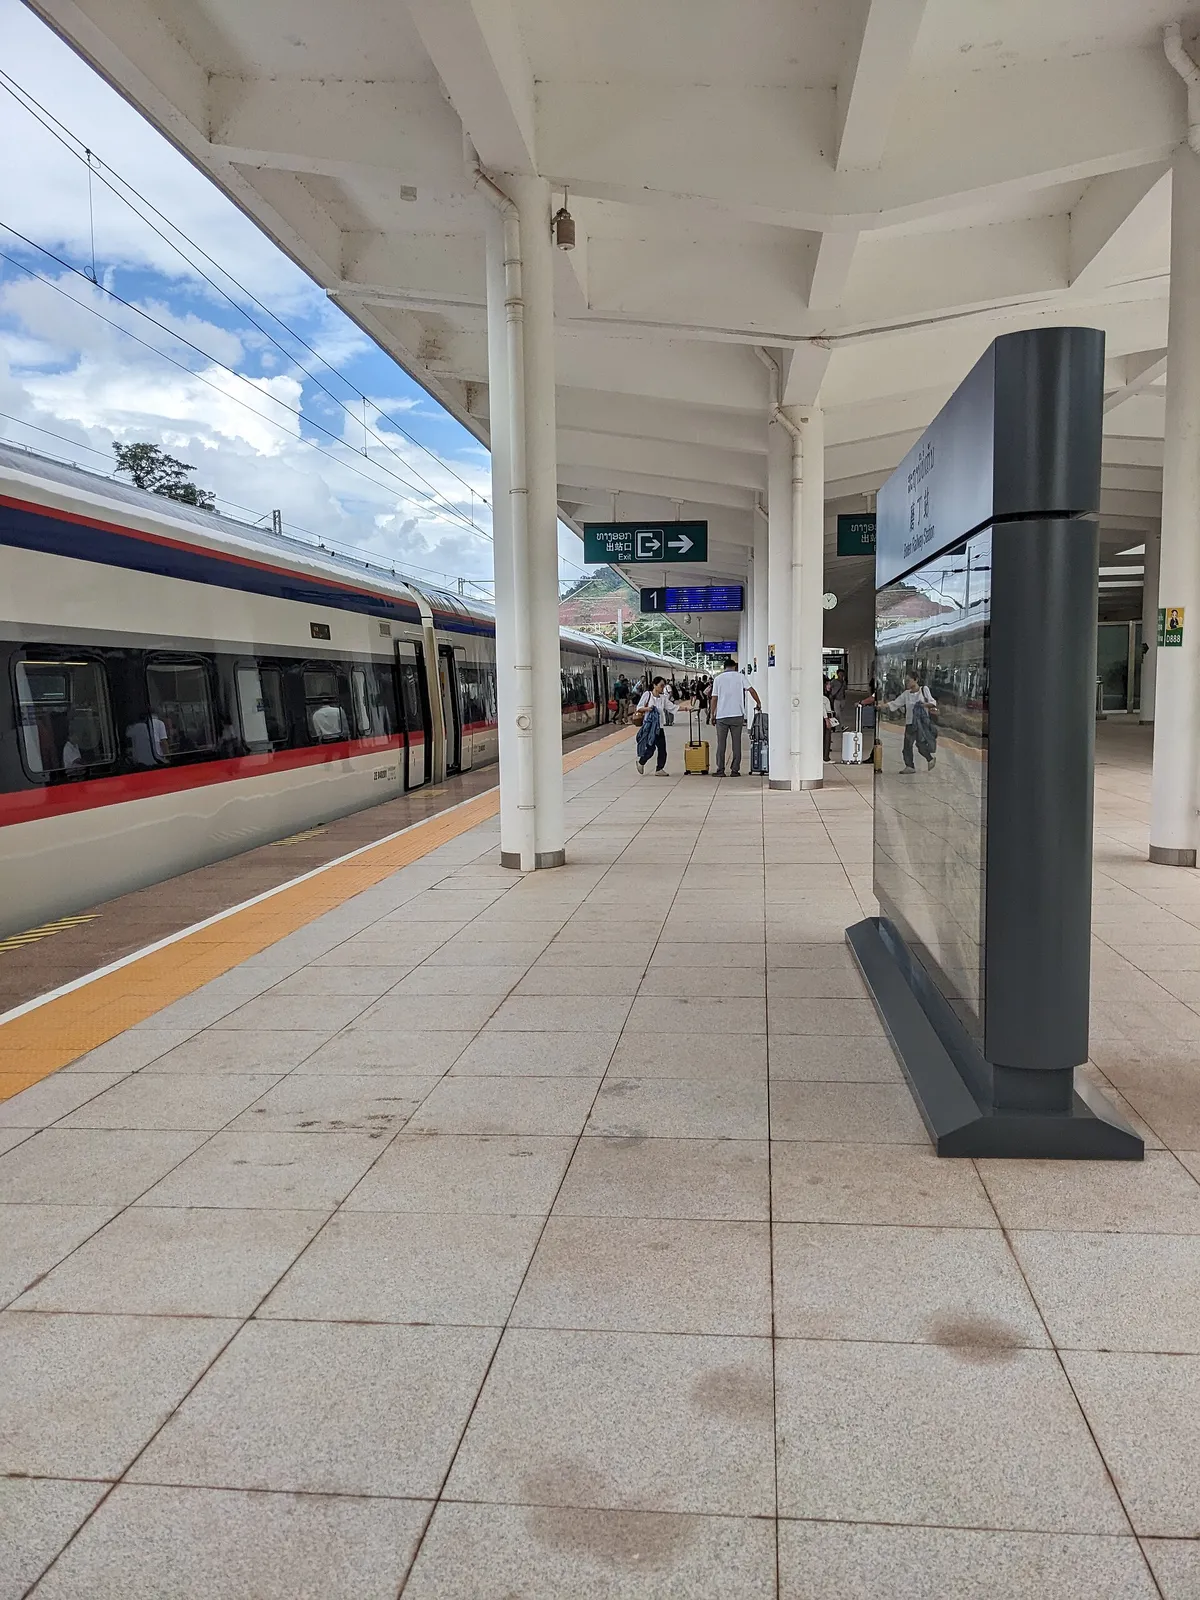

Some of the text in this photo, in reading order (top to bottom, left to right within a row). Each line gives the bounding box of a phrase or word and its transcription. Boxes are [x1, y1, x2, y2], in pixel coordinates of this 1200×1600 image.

[850, 523, 877, 533] ທາງອ
[912, 534, 924, 553] Railway
[924, 525, 935, 544] Station
[606, 542, 632, 552] 出站口
[618, 553, 632, 561] Exit
[649, 591, 658, 609] 1
